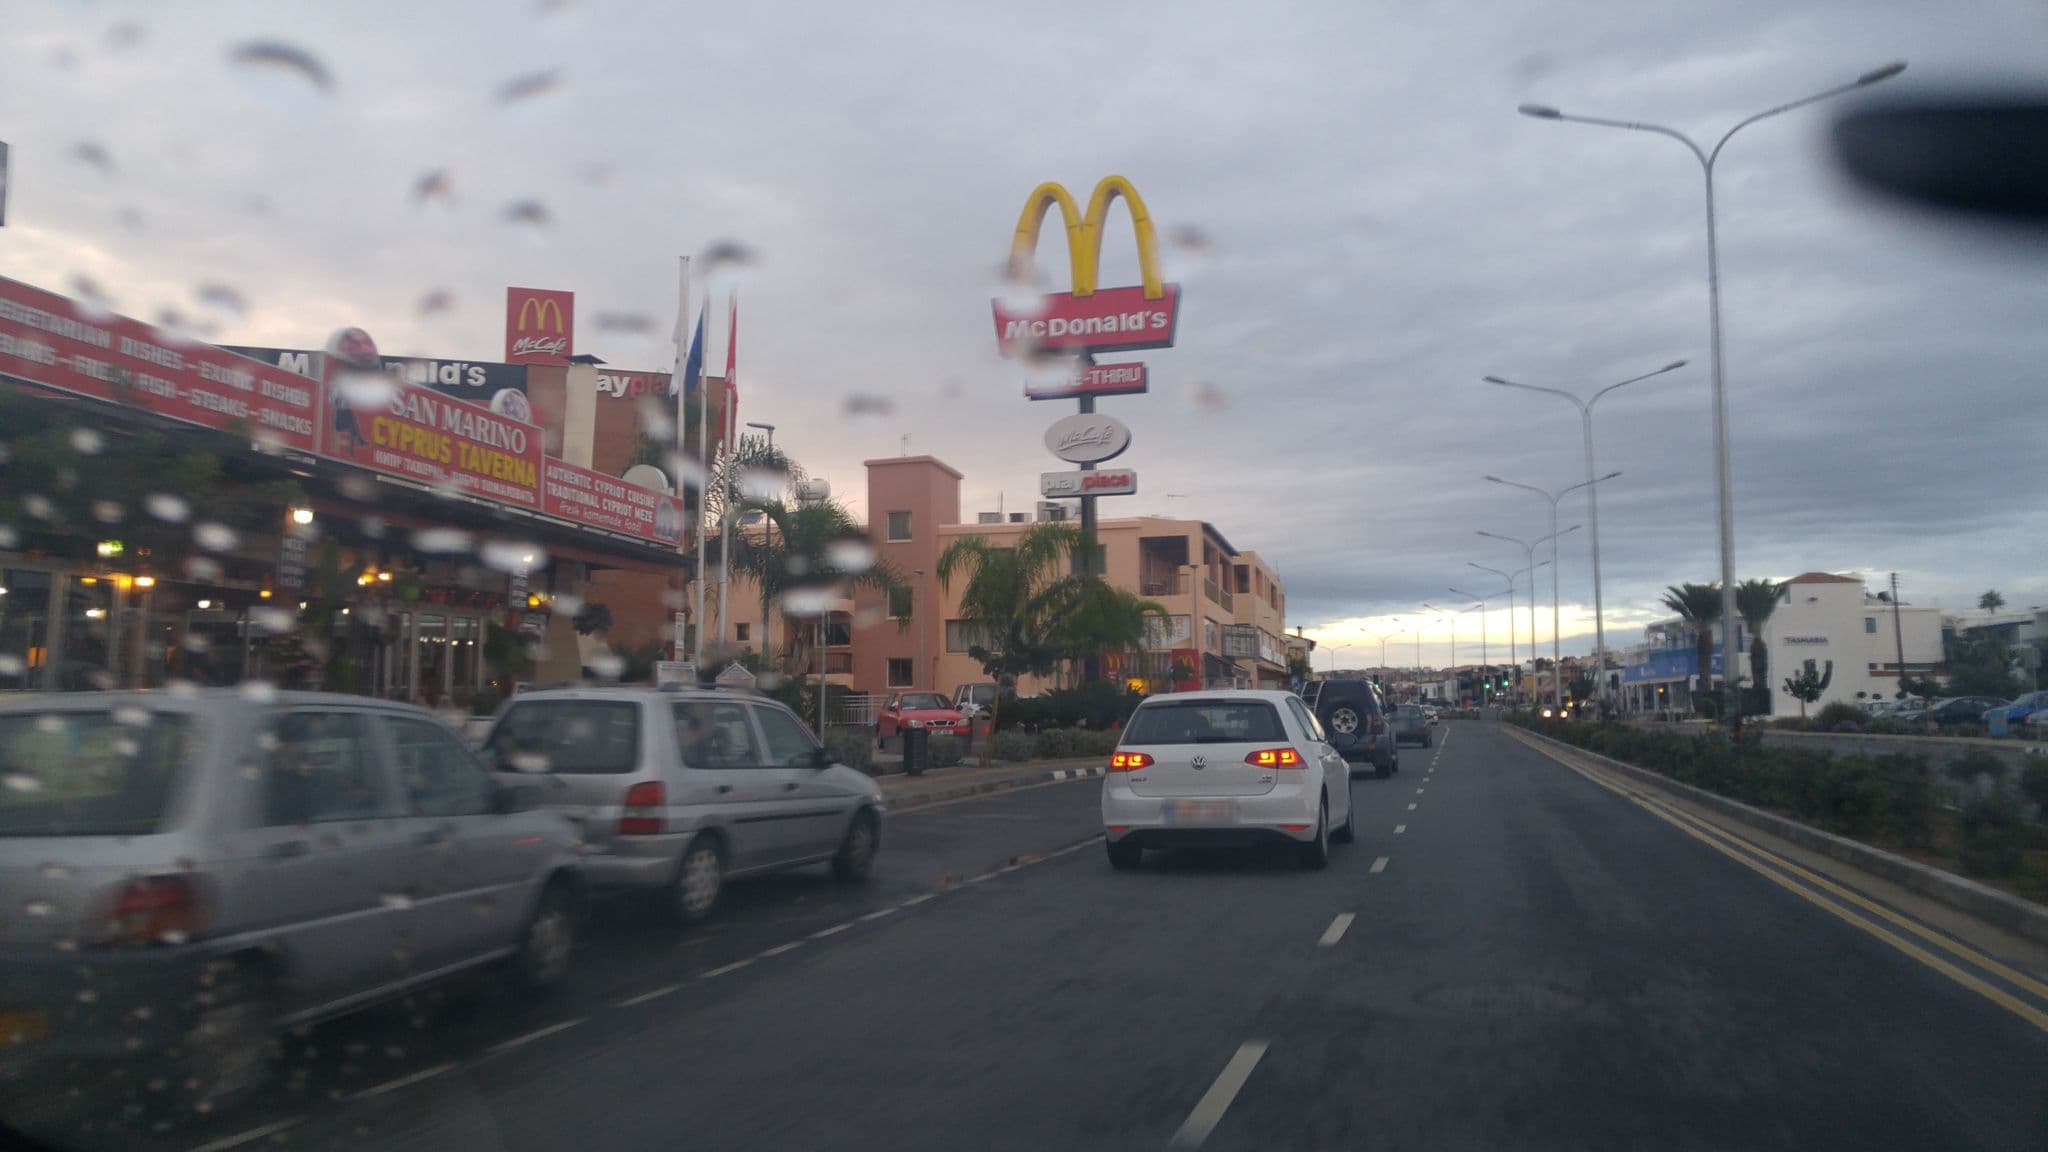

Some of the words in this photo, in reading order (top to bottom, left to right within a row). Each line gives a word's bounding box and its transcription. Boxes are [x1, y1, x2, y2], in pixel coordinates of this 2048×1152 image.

[1004, 311, 1169, 338] McDonald's
[373, 416, 451, 464] CYPRUS
[457, 441, 537, 488] TAVERNA
[391, 388, 438, 427] SAN
[443, 404, 527, 454] MARINO
